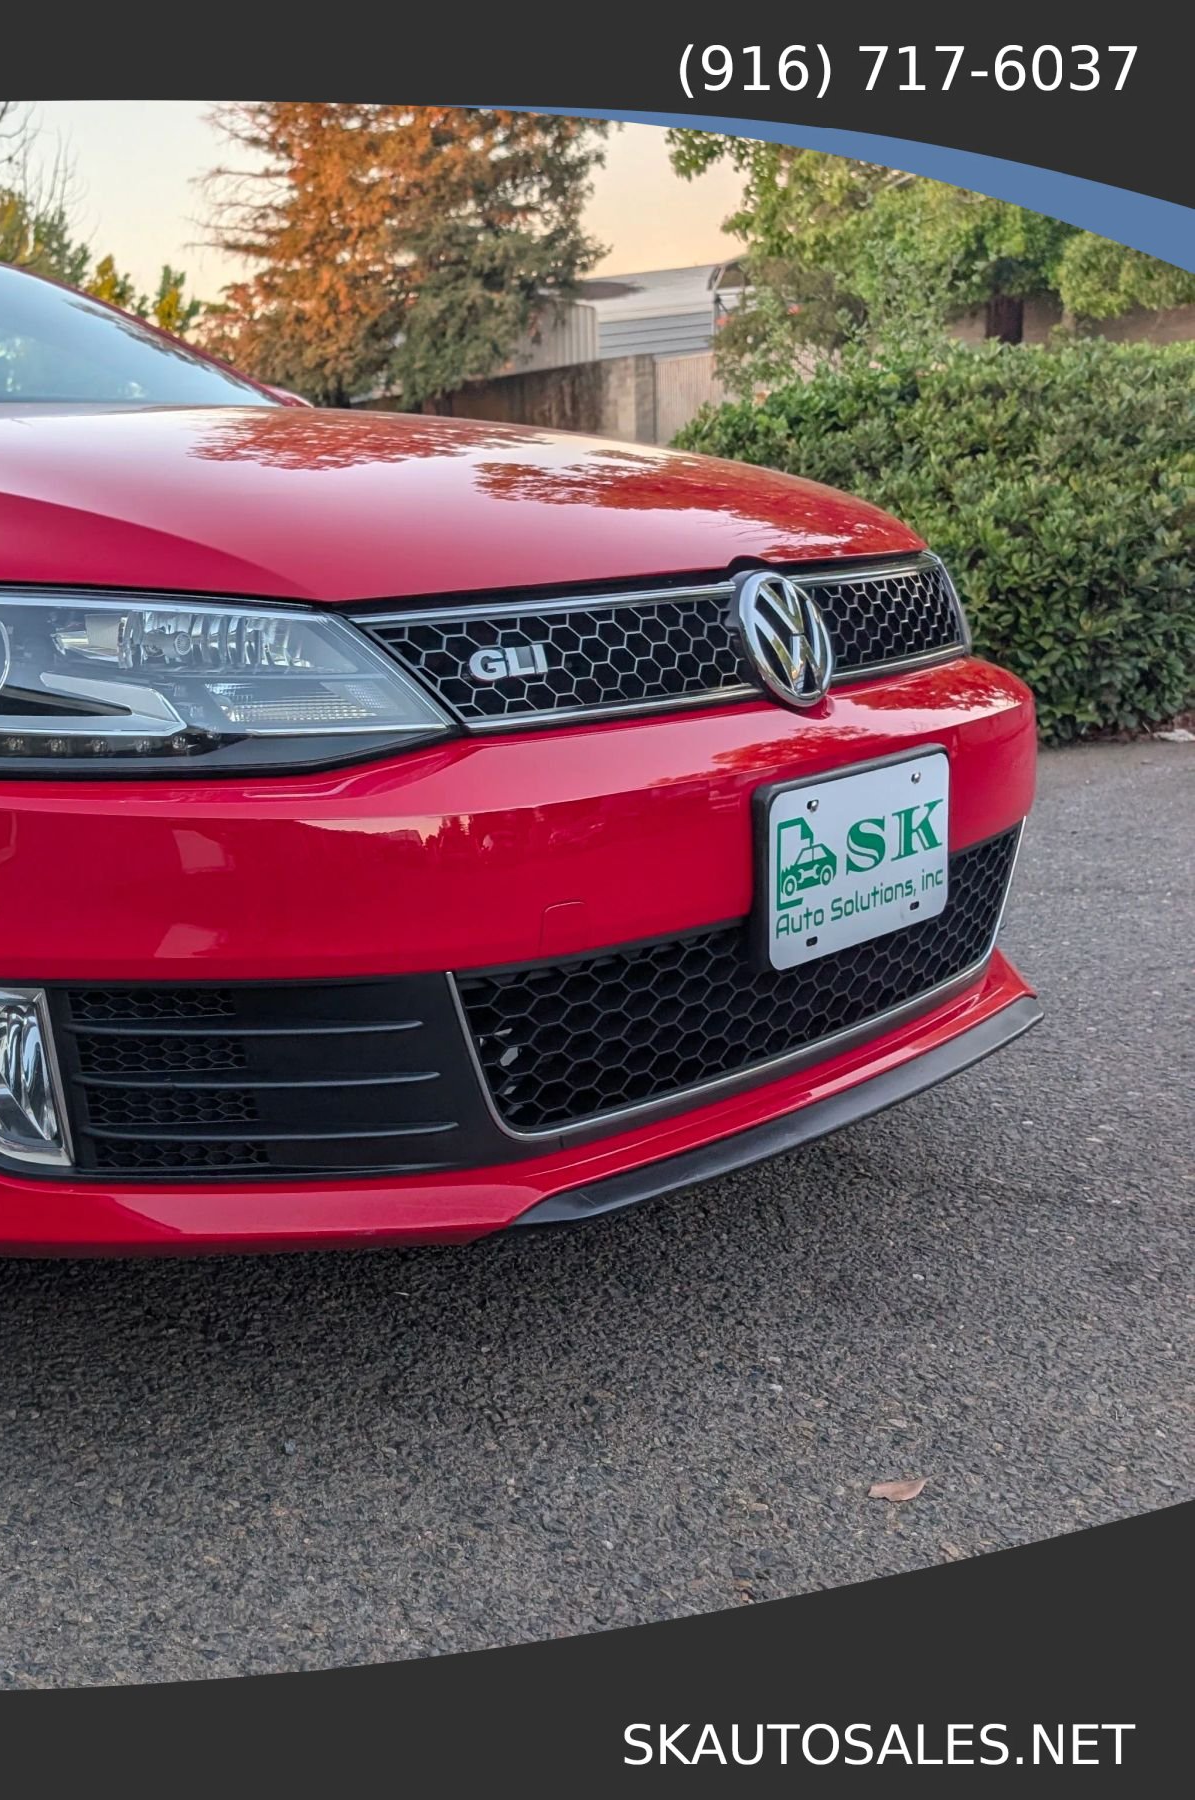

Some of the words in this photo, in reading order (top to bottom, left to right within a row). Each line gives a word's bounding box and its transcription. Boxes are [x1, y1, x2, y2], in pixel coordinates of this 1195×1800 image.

[468, 643, 548, 681] GLI
[845, 799, 944, 876] SK
[775, 906, 825, 939] Auto
[830, 878, 917, 922] Solutions,
[921, 868, 944, 892] inc
